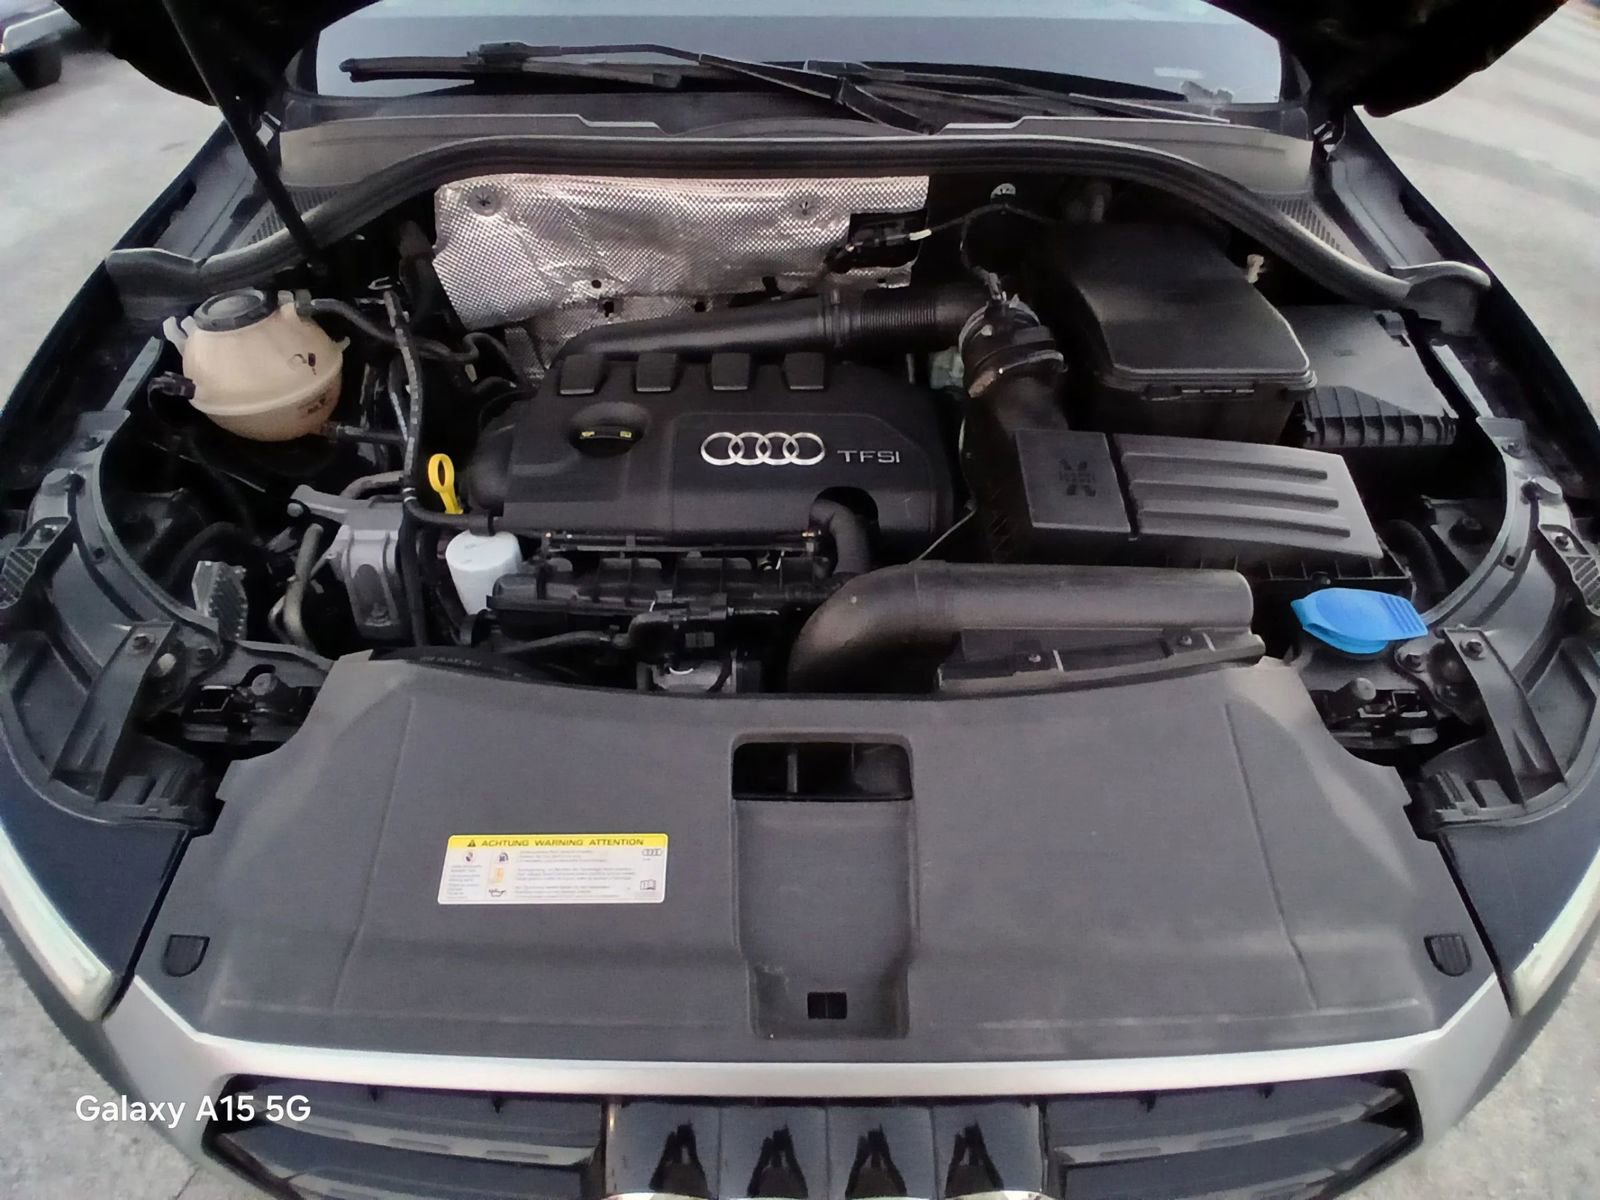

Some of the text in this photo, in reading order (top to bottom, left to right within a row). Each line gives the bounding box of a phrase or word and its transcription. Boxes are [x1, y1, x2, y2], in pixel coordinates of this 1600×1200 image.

[837, 450, 900, 463] TFSI
[481, 838, 644, 847] ACHTUNG WARNING ATTENTION
